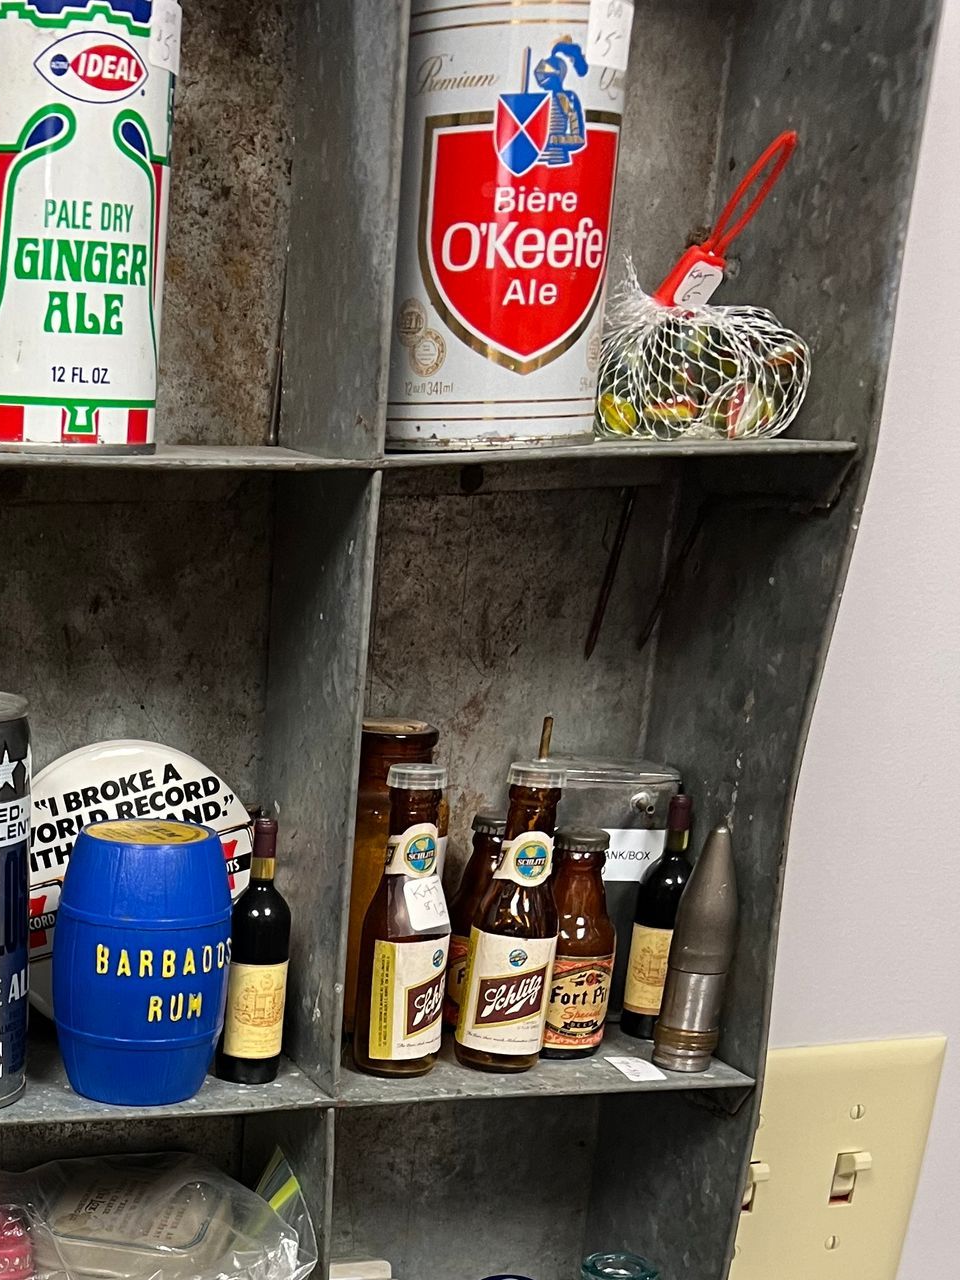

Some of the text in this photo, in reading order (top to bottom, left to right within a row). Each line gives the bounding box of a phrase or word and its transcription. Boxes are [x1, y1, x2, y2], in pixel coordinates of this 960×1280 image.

[76, 52, 139, 83] IDEAL
[44, 199, 134, 233] PALE DRY
[494, 187, 578, 214] Bière
[13, 237, 147, 287] GINGER
[441, 217, 604, 273] O'Keefe
[502, 279, 558, 306] Ale
[43, 290, 125, 336] ALE
[51, 366, 111, 385] 12 FL. OZ.
[62, 768, 154, 812] BROKE
[153, 763, 183, 790] A
[115, 775, 221, 820] RECORD
[605, 848, 652, 862] ANK/BOX
[95, 936, 233, 979] BARBADOS
[147, 991, 203, 1022] RUM
[480, 974, 543, 1018] Schlitz
[549, 985, 589, 1006] Fort
